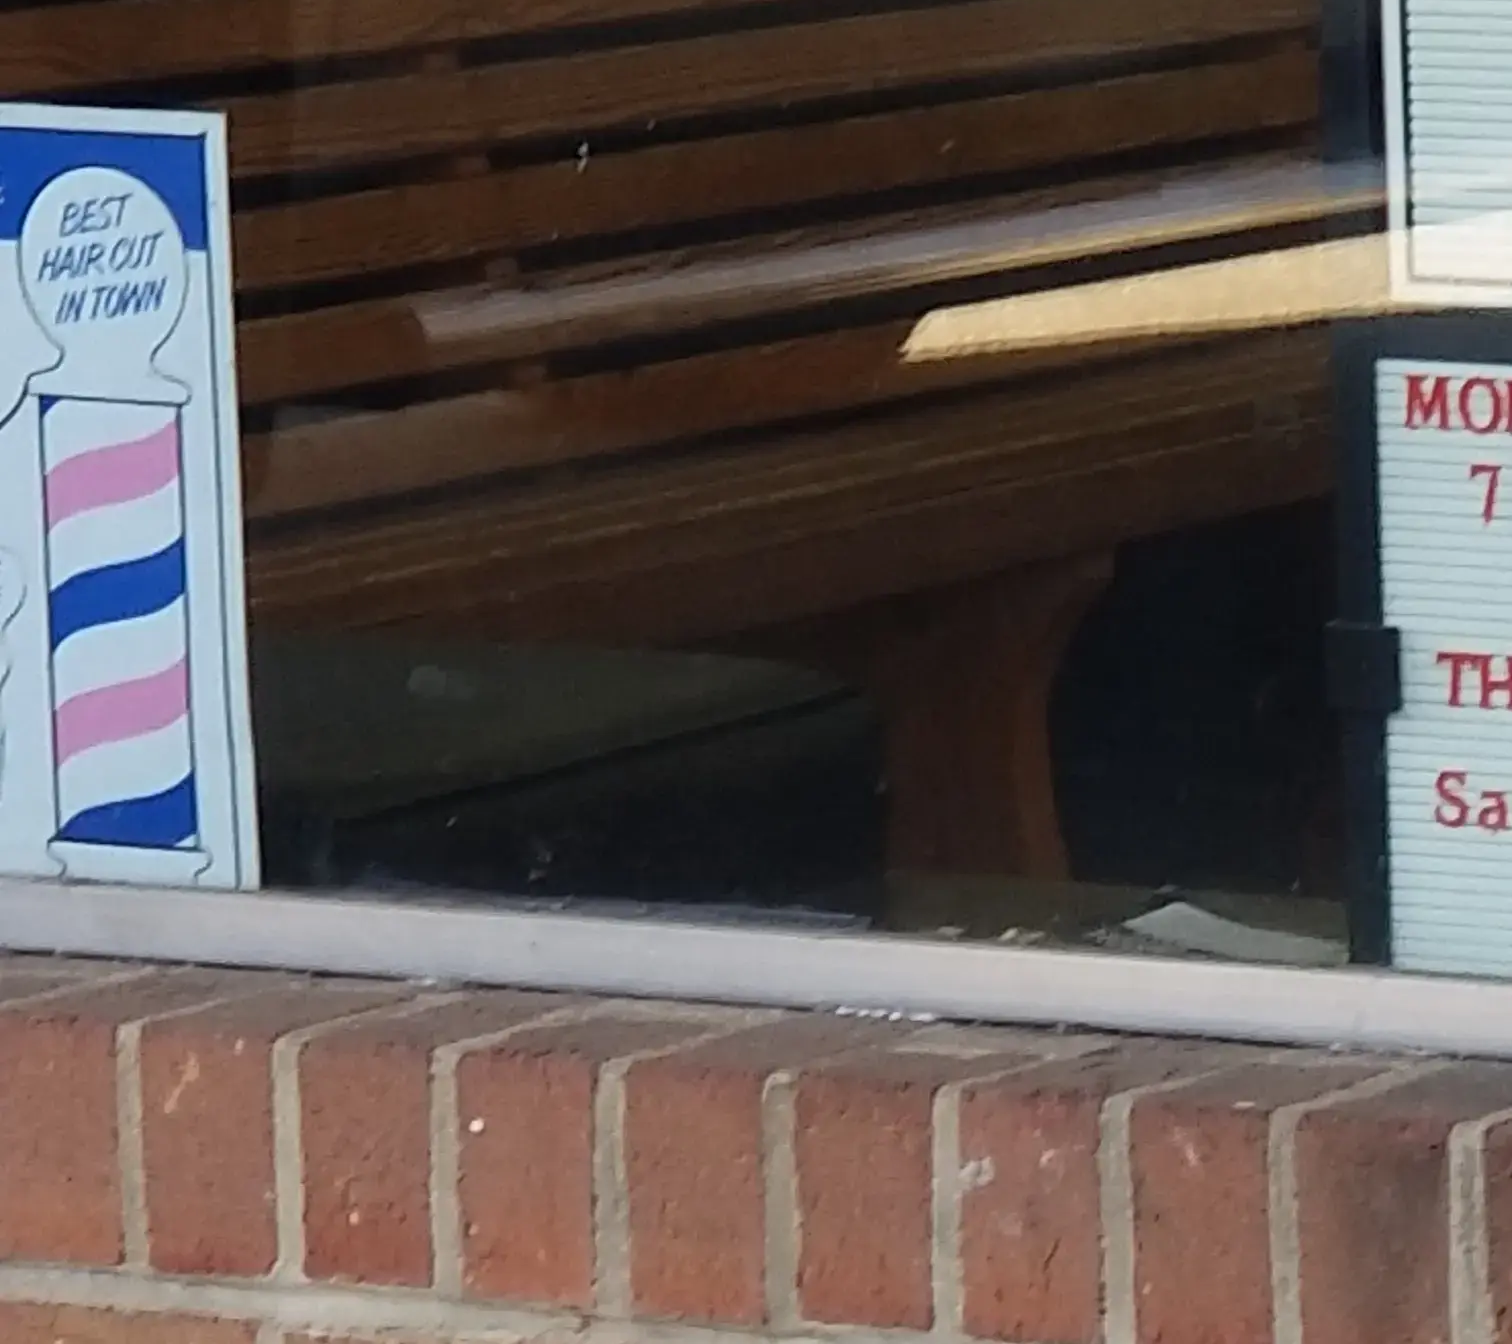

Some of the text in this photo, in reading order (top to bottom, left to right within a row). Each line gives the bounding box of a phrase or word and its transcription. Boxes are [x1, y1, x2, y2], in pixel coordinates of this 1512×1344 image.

[60, 194, 132, 237] BEST
[38, 230, 164, 281] HAIR CUT
[55, 276, 168, 325] IN TOWN
